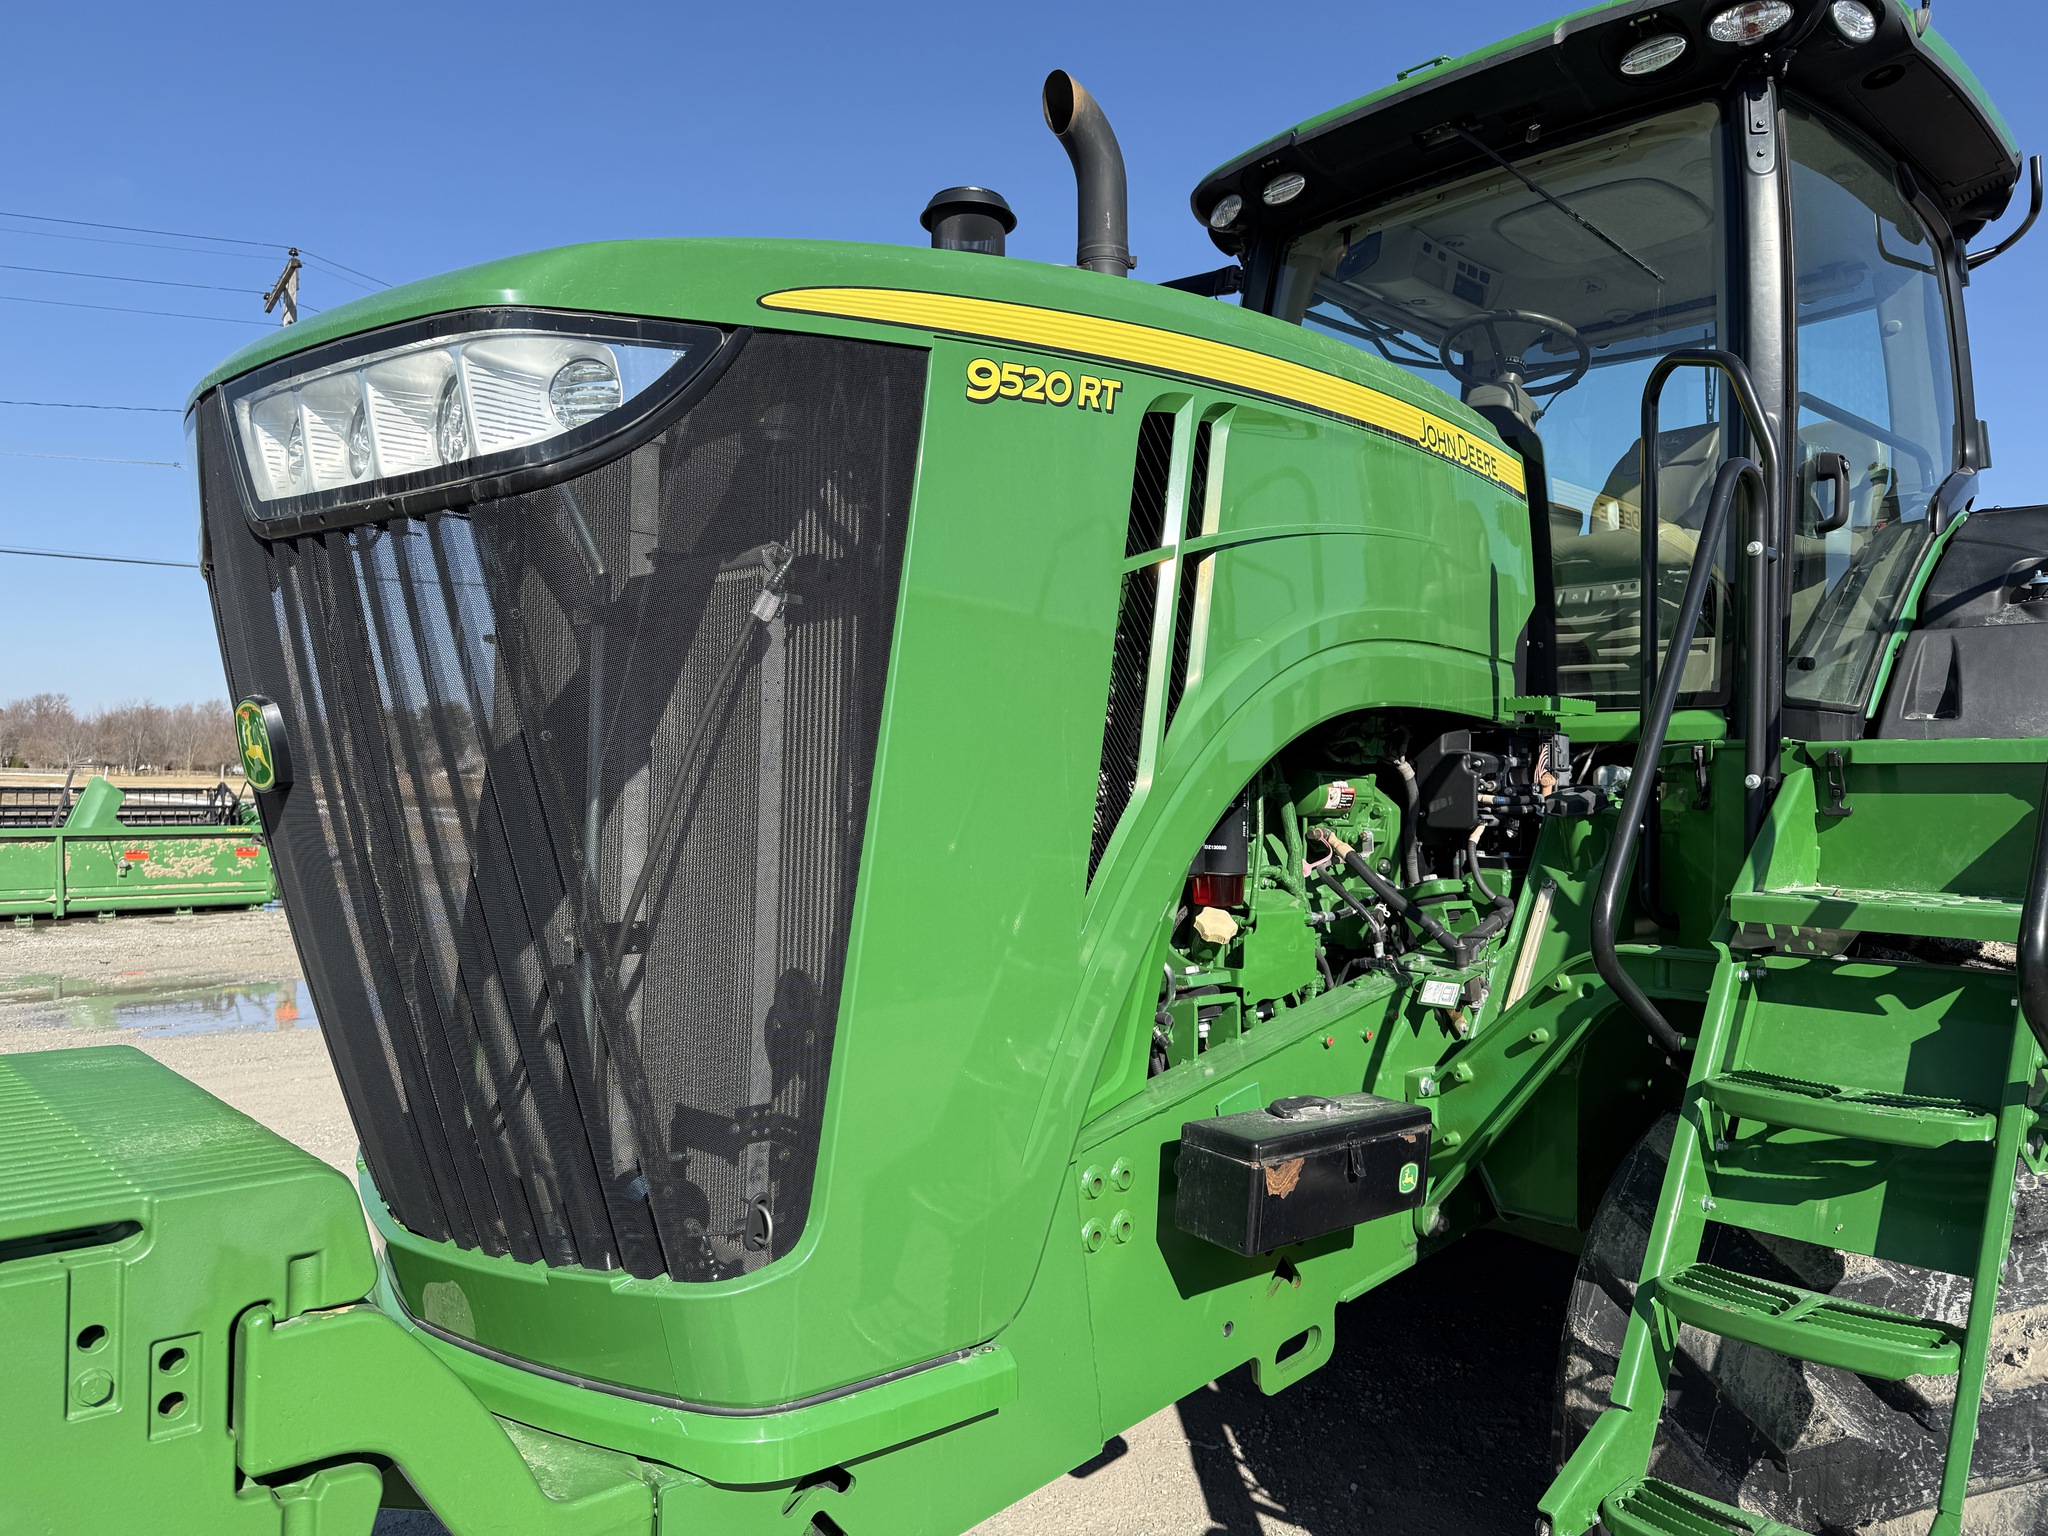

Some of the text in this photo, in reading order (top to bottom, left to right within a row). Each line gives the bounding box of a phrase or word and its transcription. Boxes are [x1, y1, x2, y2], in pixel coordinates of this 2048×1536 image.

[966, 358, 1123, 414] 9520 RT
[1419, 416, 1499, 479] JOHN DEERE
